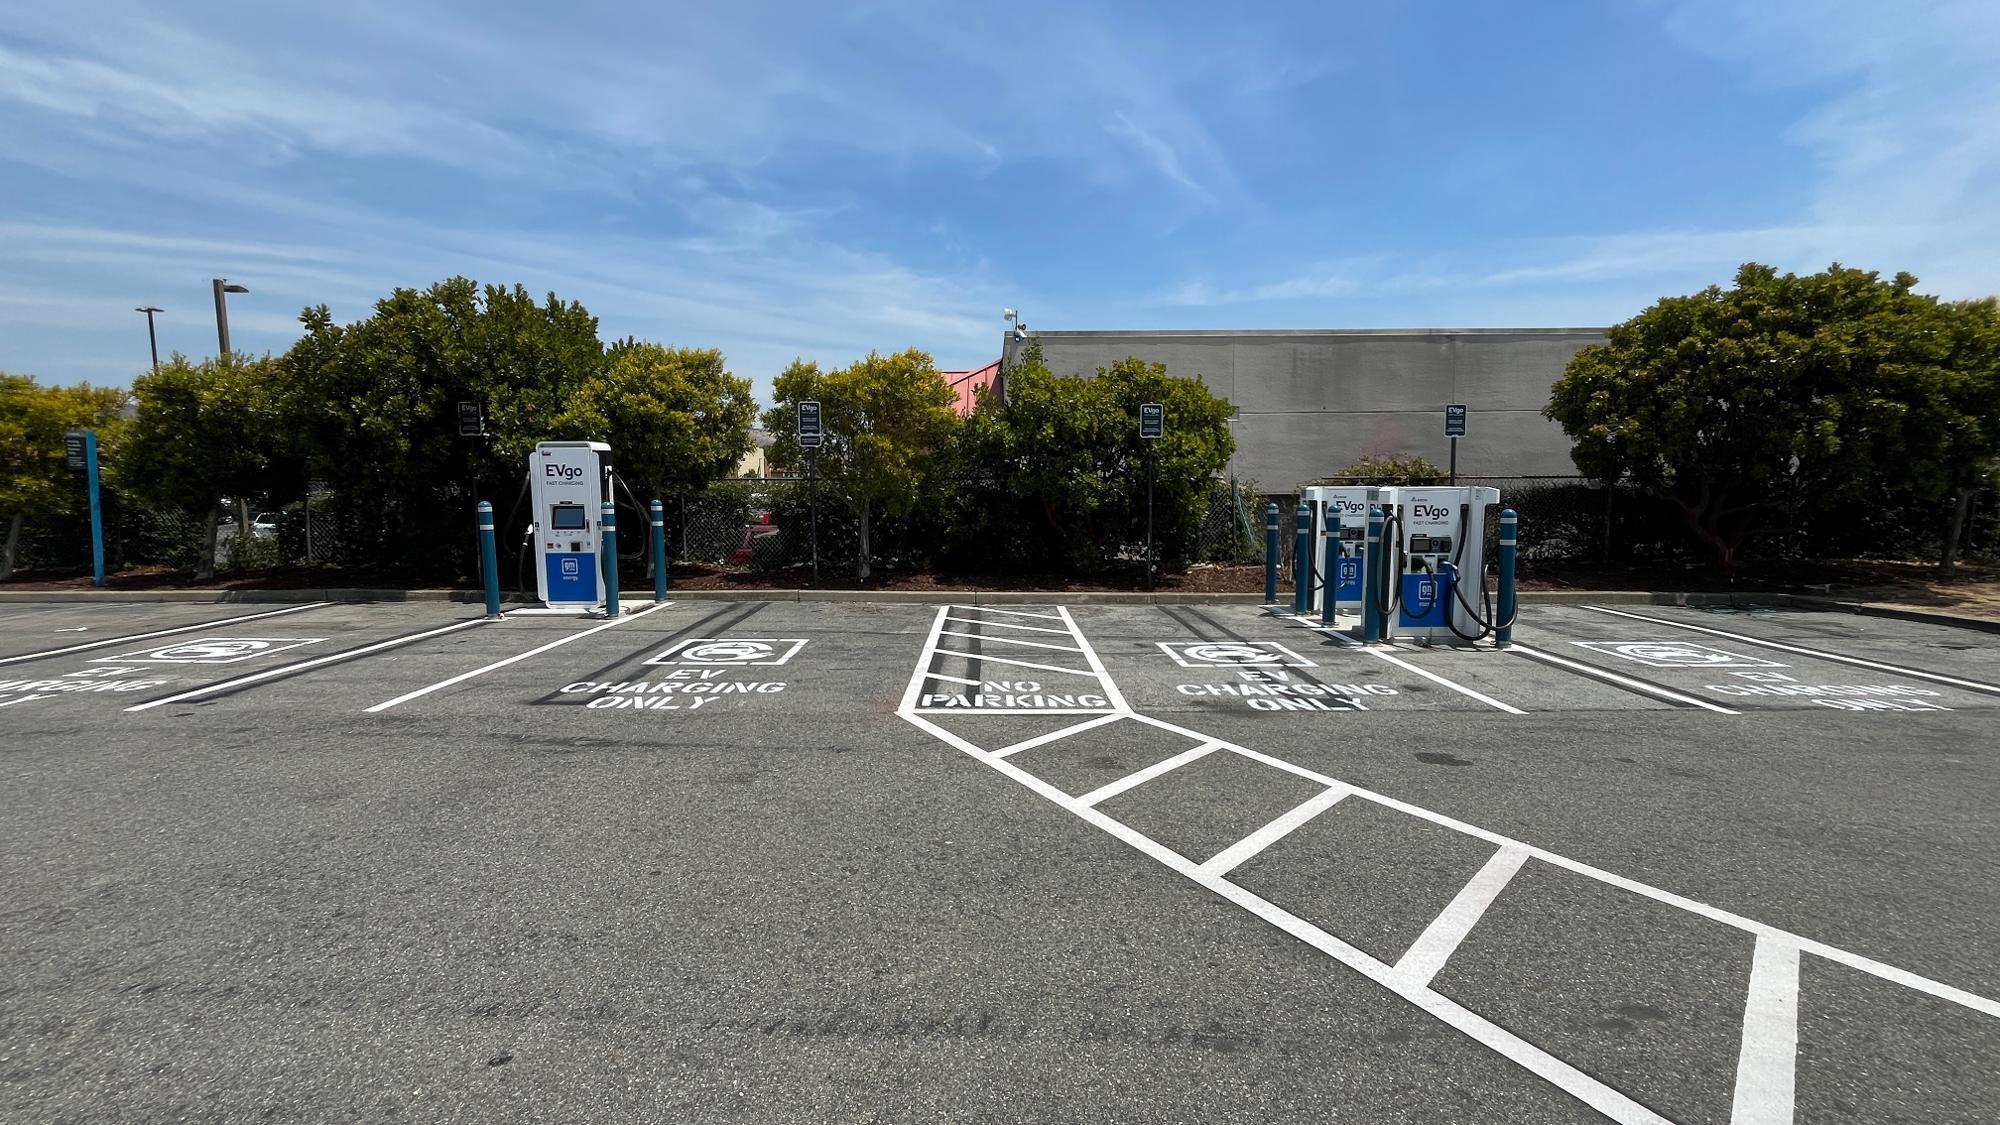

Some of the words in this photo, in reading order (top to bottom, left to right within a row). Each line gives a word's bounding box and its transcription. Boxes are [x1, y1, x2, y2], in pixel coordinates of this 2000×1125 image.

[545, 463, 583, 480] EVgo
[1413, 504, 1449, 520] EVgo
[665, 669, 728, 679] EV
[1236, 671, 1290, 682] EV
[1727, 672, 1799, 682] EV
[559, 681, 788, 694] CHARGING
[984, 680, 1042, 692] NO
[1175, 683, 1400, 696] CHARGING
[1704, 684, 1942, 696] CHARGING
[585, 696, 721, 710] ONLY
[921, 694, 1107, 708] PARKING
[1245, 697, 1370, 711] ONLY
[1811, 699, 1954, 711] ONLY
